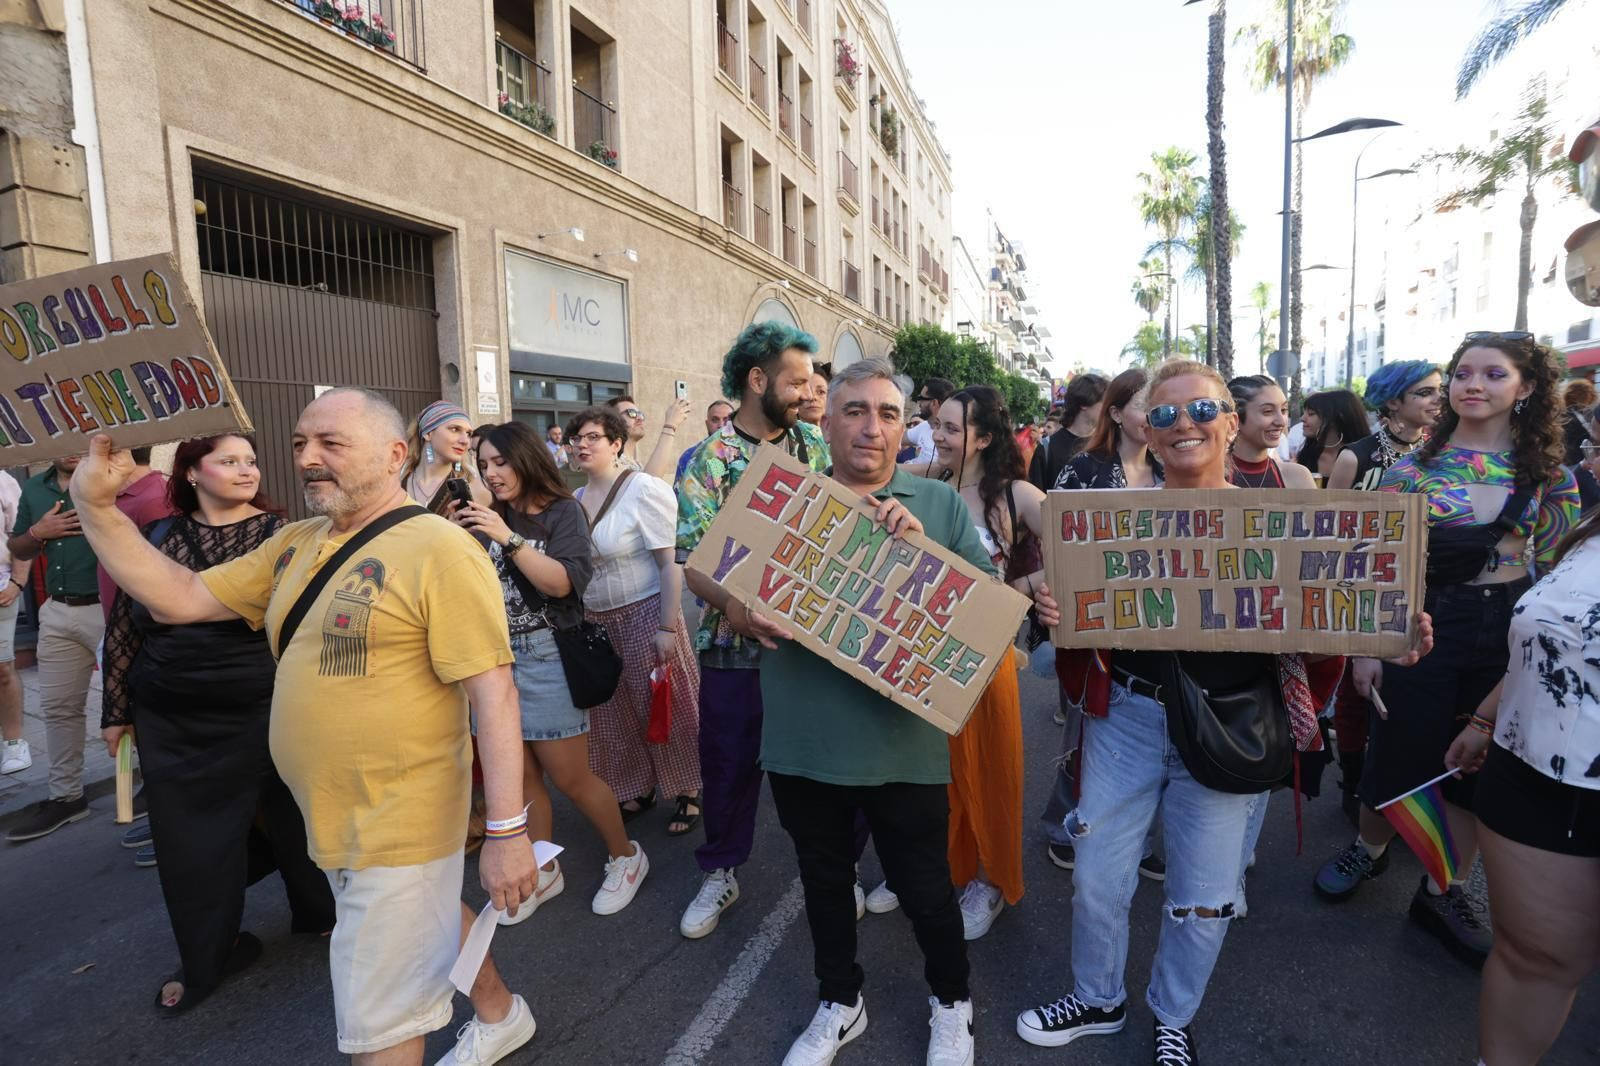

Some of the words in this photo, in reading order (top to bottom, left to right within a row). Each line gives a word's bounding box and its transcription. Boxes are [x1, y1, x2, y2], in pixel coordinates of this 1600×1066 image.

[563, 293, 601, 326] MC
[1061, 509, 1225, 542] NUESTROS
[1243, 509, 1405, 541] COLORES
[712, 536, 752, 582] Y
[1300, 542, 1397, 582] MÁS
[1075, 587, 1177, 631] CON
[1200, 586, 1285, 631] LOS
[1301, 581, 1407, 634] AÑOS
